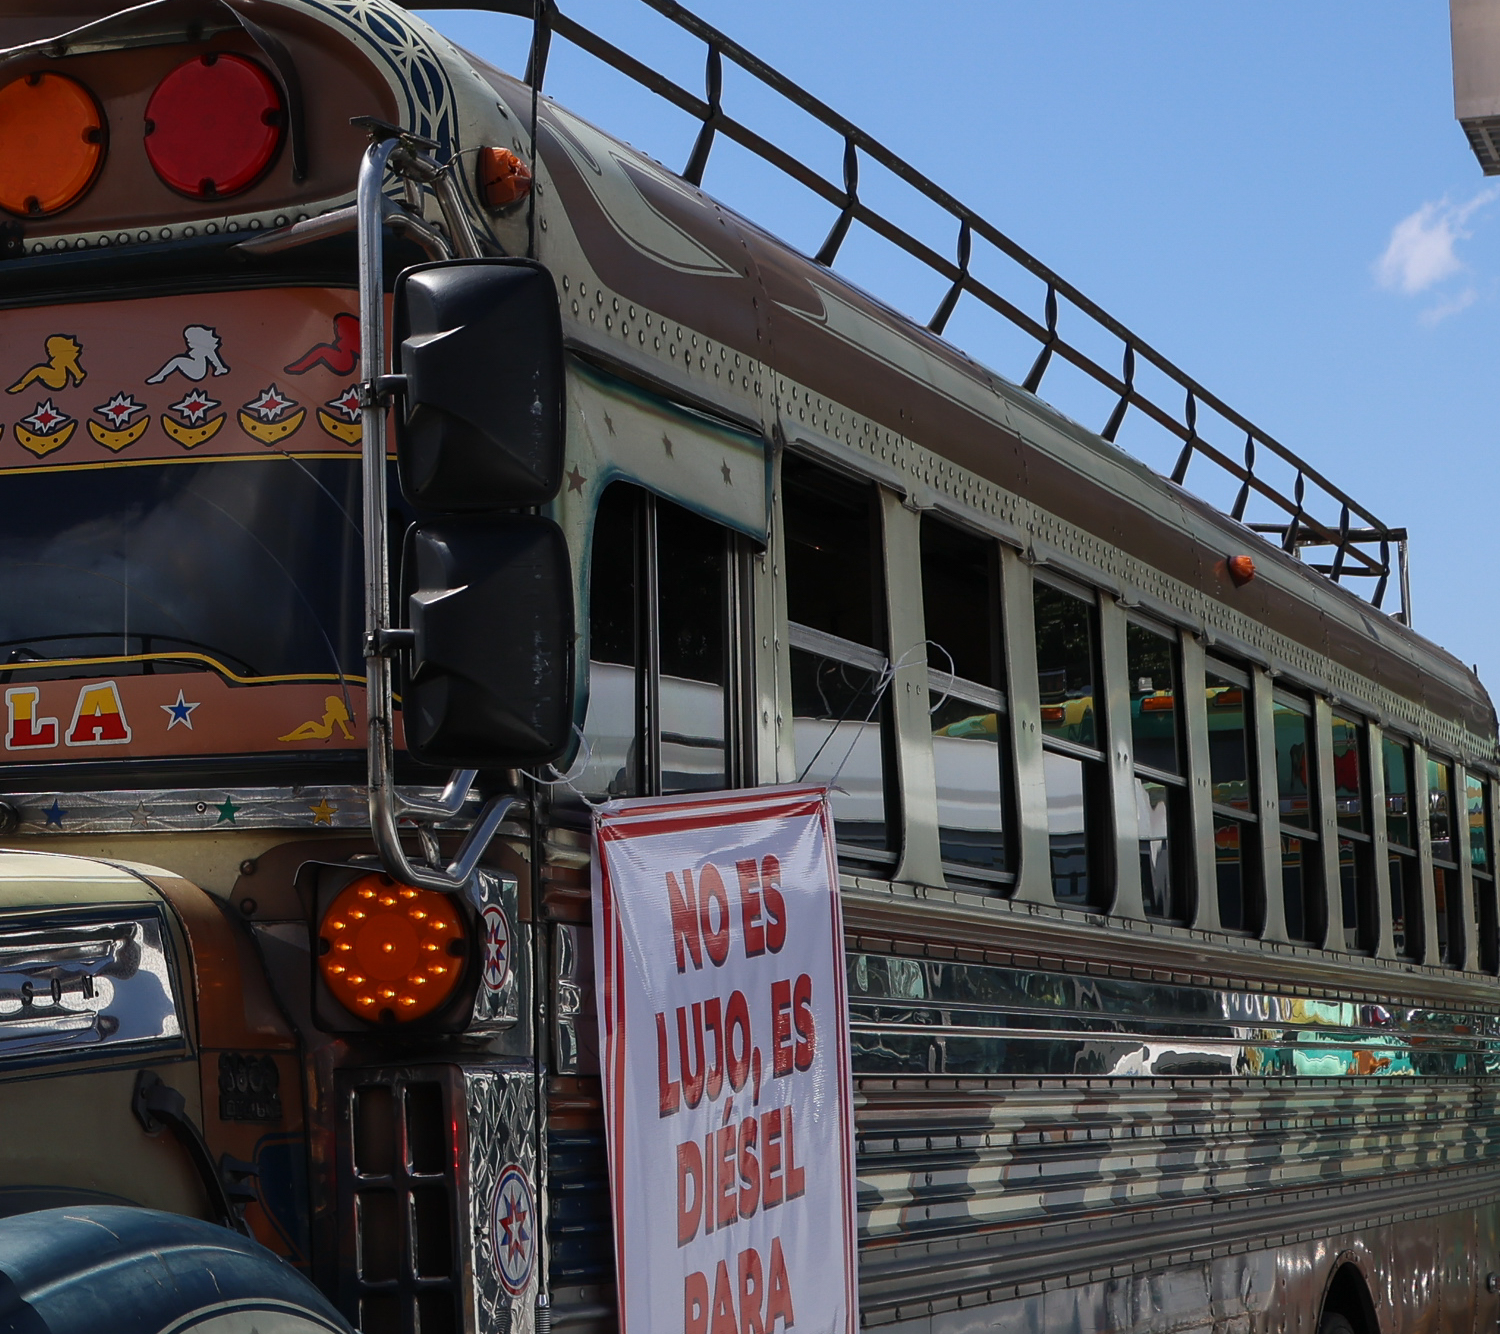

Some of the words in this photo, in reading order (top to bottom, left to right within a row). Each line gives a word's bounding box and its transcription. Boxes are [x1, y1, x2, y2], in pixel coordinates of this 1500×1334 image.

[666, 862, 730, 974] NO
[736, 854, 787, 959] ES
[655, 990, 761, 1119] LUJO,
[771, 973, 816, 1079] ES
[677, 1097, 806, 1248] DIÉSEL
